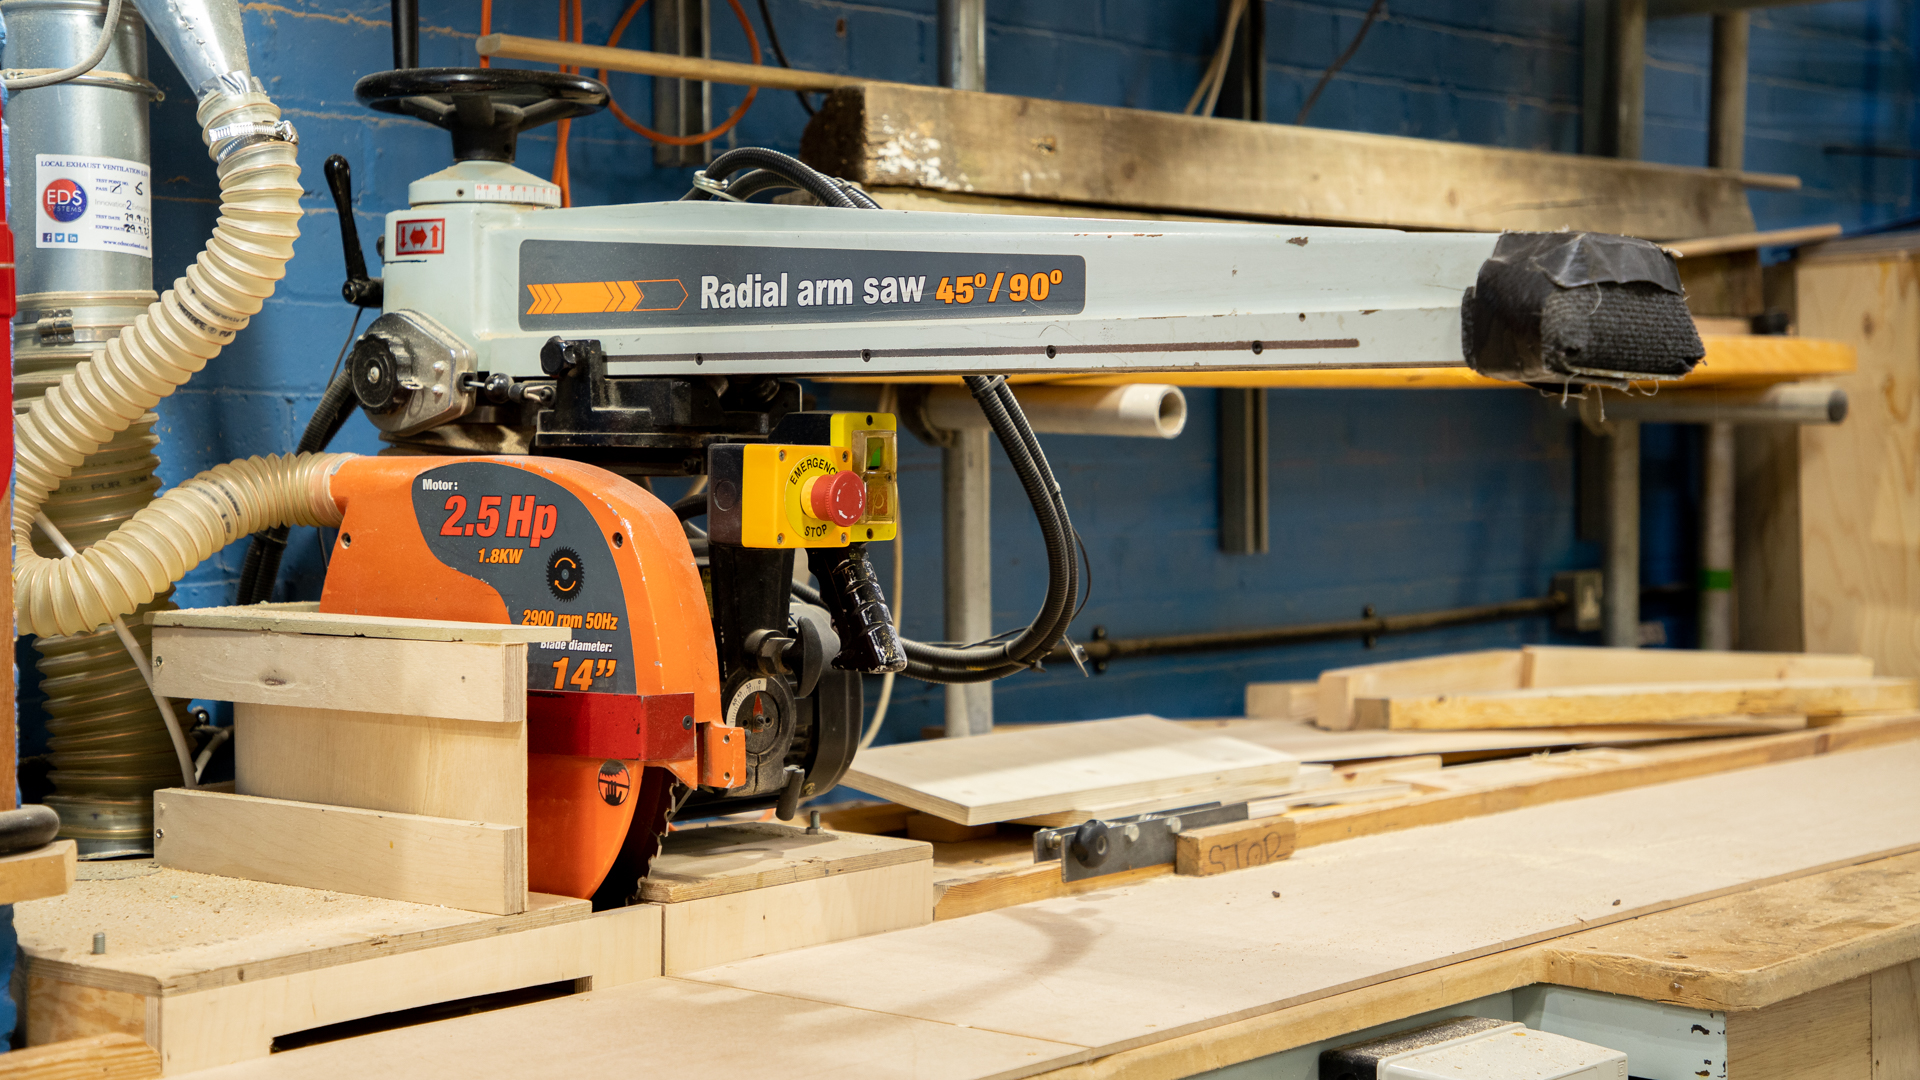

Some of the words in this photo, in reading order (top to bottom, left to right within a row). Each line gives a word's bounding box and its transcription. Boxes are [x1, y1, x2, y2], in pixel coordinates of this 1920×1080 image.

[66, 161, 101, 169] EXHAUST
[103, 164, 141, 175] VENTILATION
[47, 189, 82, 206] EDS
[47, 205, 82, 213] SYSTEMS
[700, 272, 788, 310] Radial
[797, 277, 853, 307] arm
[862, 274, 926, 305] saw
[789, 457, 840, 485] EMERGENC
[422, 478, 458, 490] Motor:
[439, 494, 502, 538] 2.5
[505, 495, 558, 548] Hp
[804, 524, 828, 538] STOP
[477, 547, 523, 564] 1.8KW
[521, 608, 555, 627] 2900
[556, 614, 583, 629] rpm
[585, 612, 619, 631] 50Hz
[568, 639, 613, 653] diameter:
[1208, 831, 1281, 872] STOP
